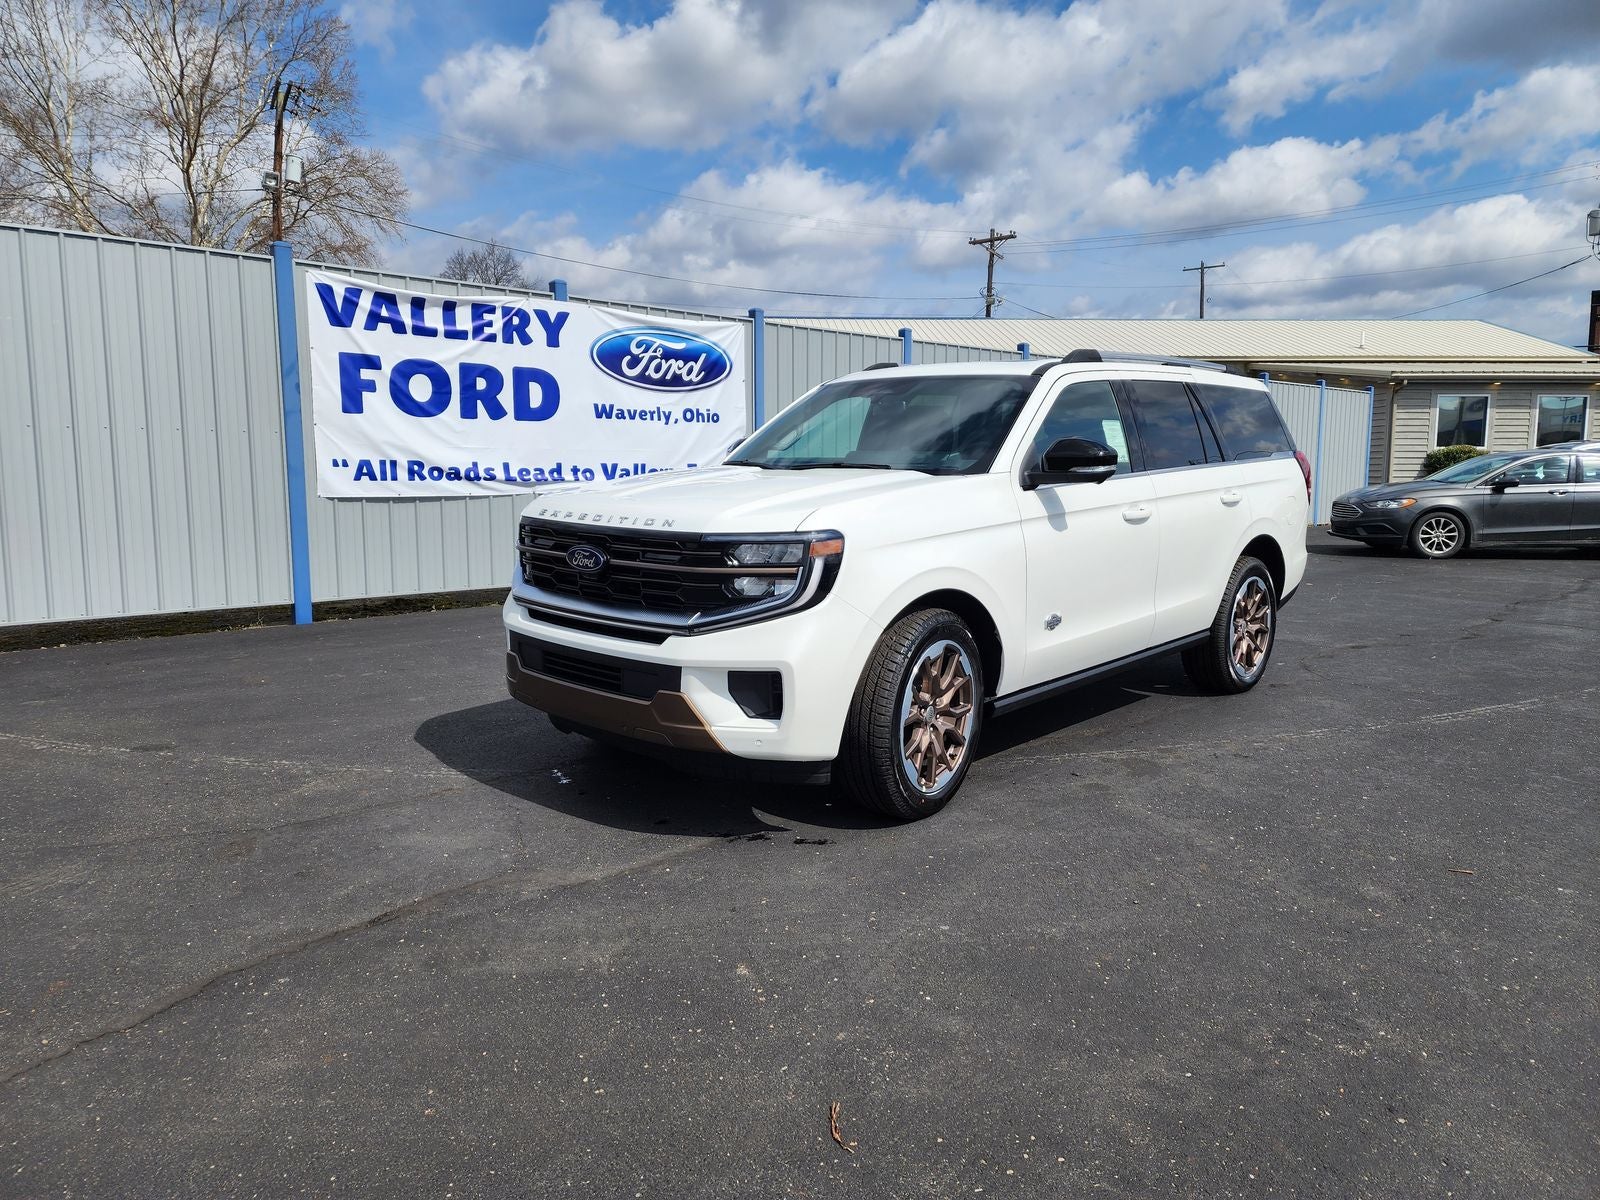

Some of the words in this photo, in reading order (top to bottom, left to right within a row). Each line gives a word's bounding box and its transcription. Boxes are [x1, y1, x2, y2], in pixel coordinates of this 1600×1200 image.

[314, 282, 570, 348] VALLERY
[621, 336, 707, 382] Ford
[338, 351, 561, 422] FORD
[593, 403, 679, 425] Waverly,
[682, 407, 720, 424] Ohio
[407, 460, 497, 482] Roads
[502, 462, 566, 482] Lead
[571, 465, 595, 482] to
[538, 508, 676, 528] EXPEDITION
[572, 549, 596, 568] Ford
